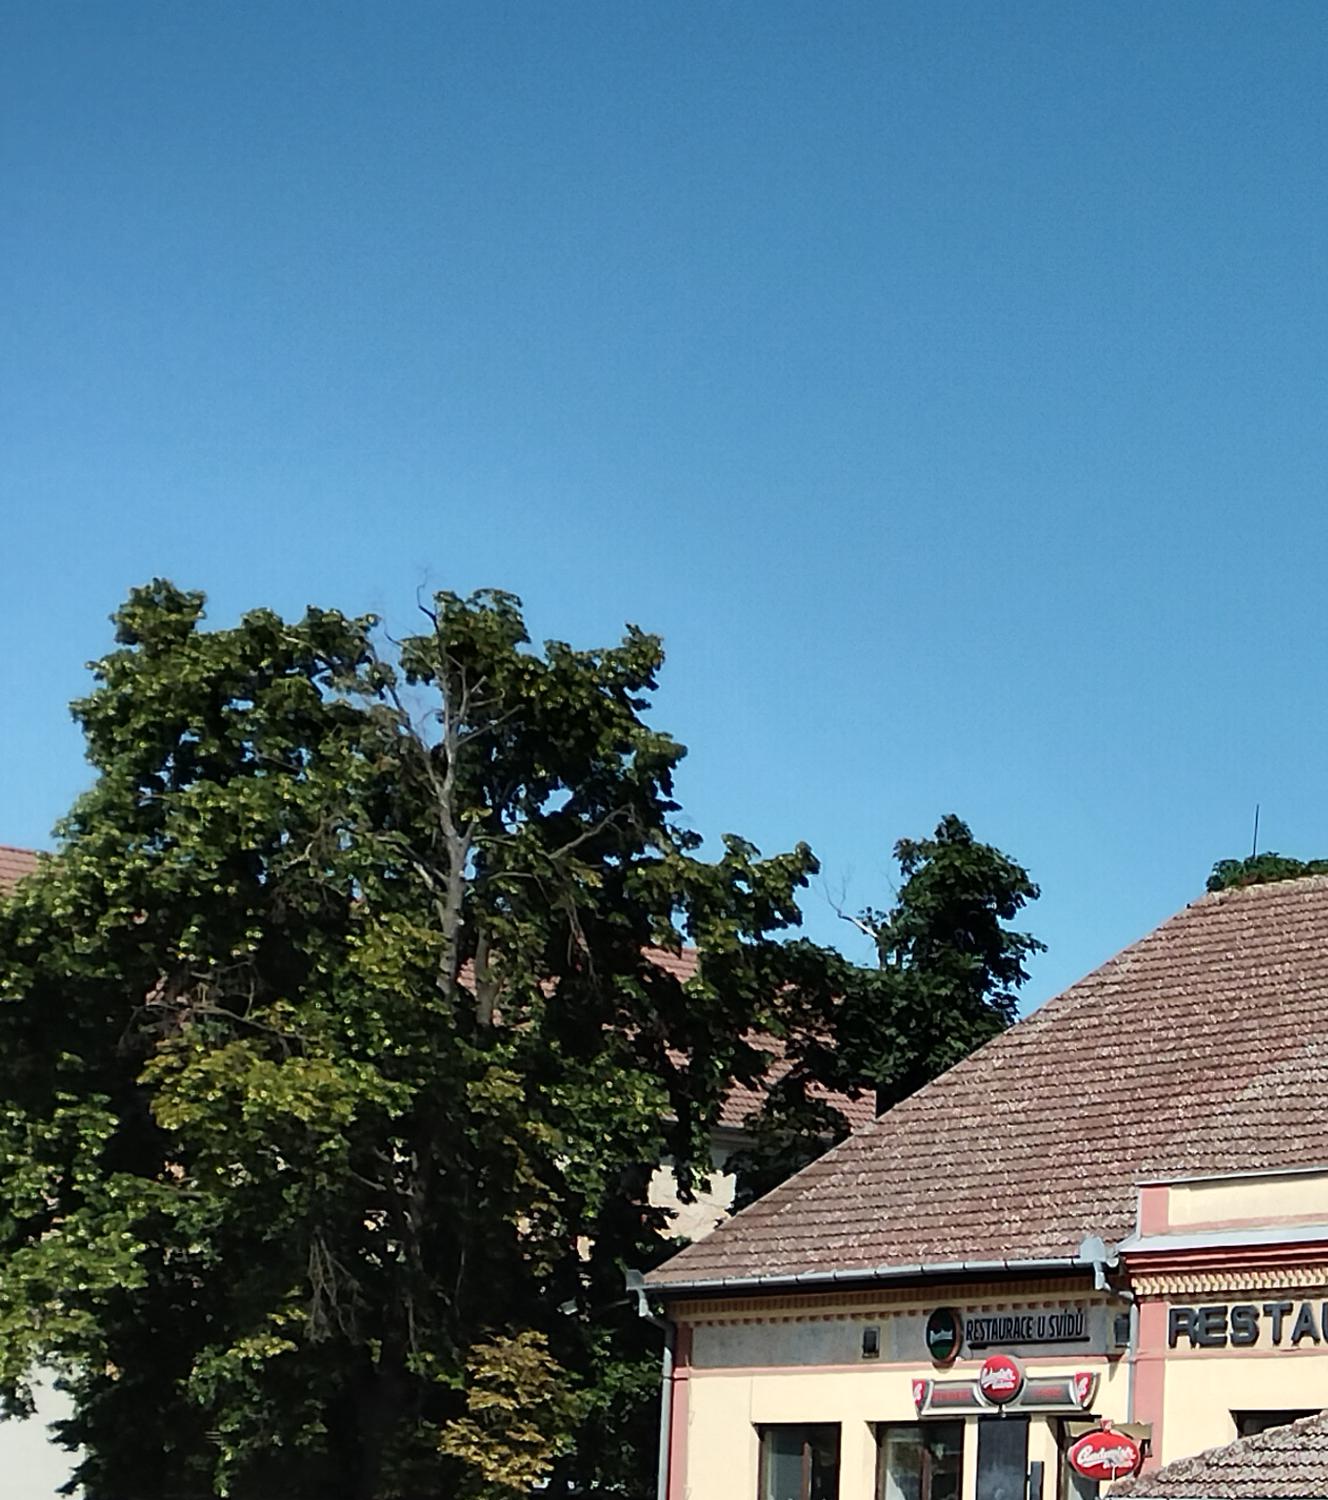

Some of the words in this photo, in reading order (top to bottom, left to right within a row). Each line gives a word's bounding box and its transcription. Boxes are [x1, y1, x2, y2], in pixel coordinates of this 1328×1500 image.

[966, 1315, 1033, 1341] RESTAURACE
[1037, 1318, 1045, 1338] U
[1049, 1308, 1084, 1337] SVÍDŮ
